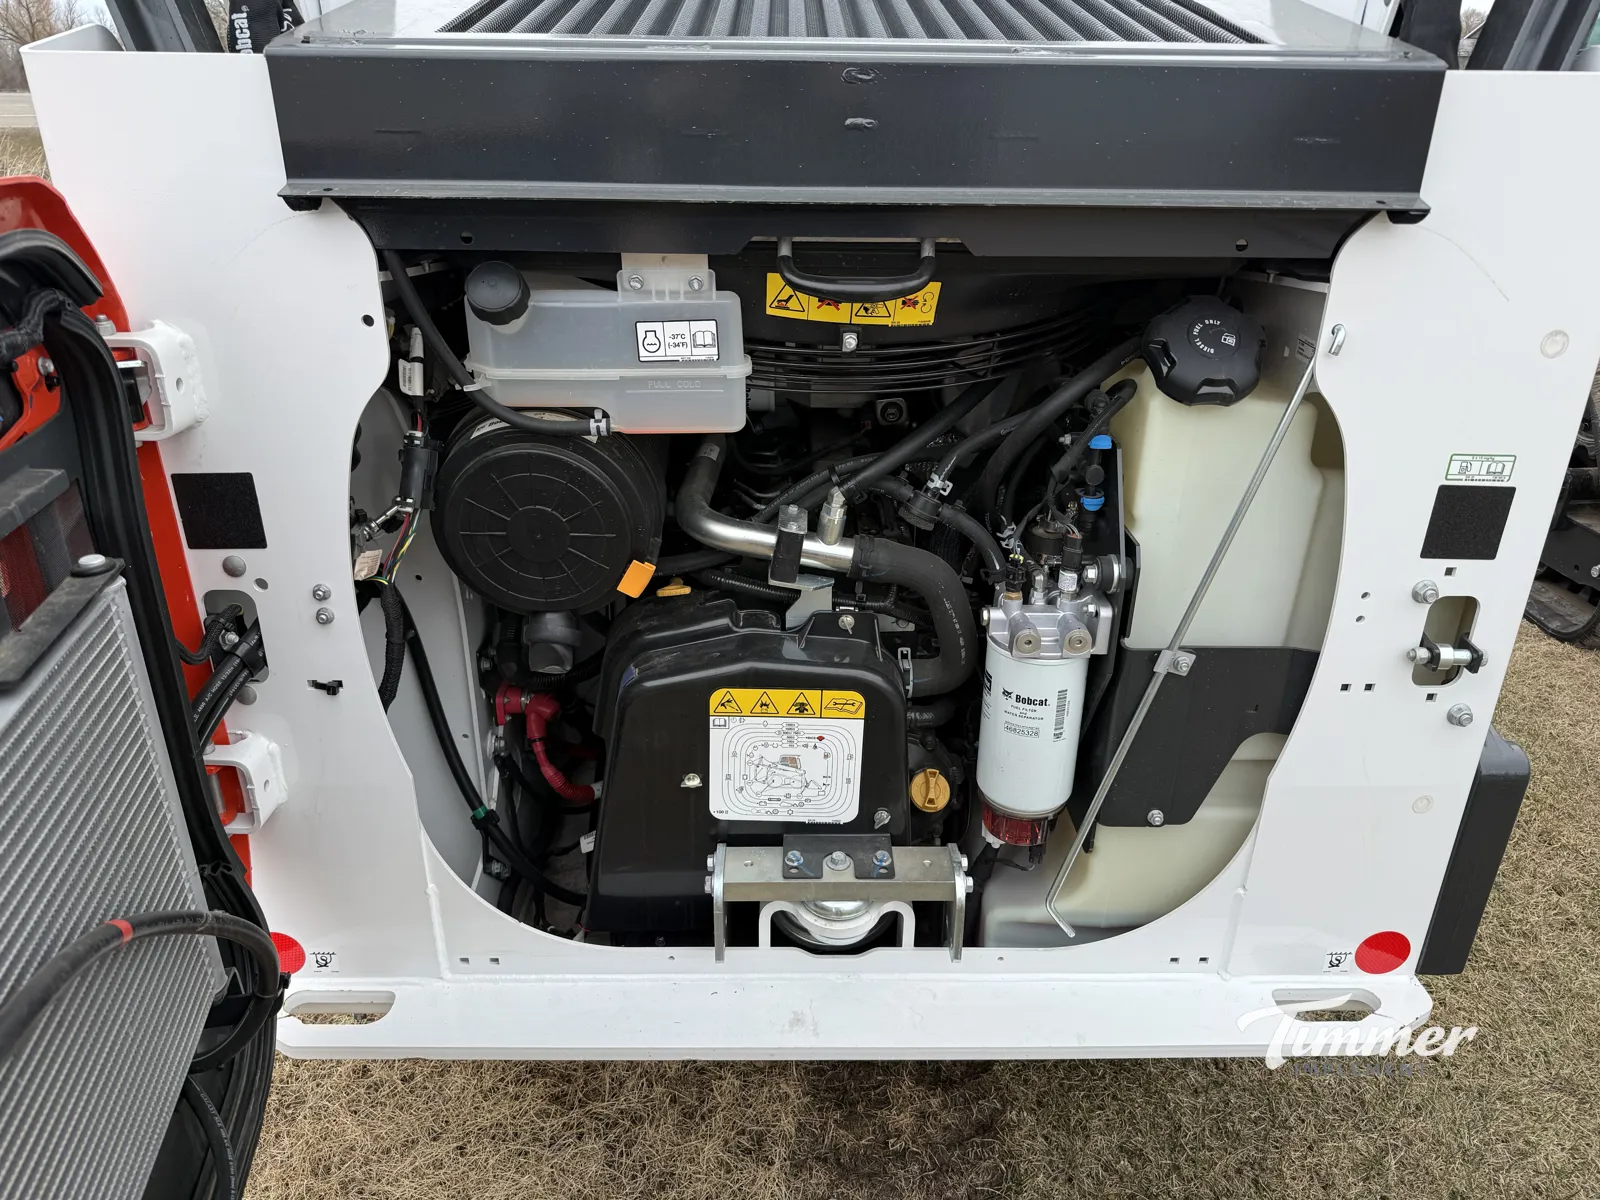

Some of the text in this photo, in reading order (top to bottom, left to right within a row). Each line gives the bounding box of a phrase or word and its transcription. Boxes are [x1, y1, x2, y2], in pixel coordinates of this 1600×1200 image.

[1192, 323, 1204, 335] FUEL
[1194, 338, 1215, 354] DIESEL
[647, 380, 701, 389] FULL COLD
[211, 680, 222, 693] HOSE
[1015, 694, 1049, 707] Bobcat
[1003, 709, 1018, 717] WATER
